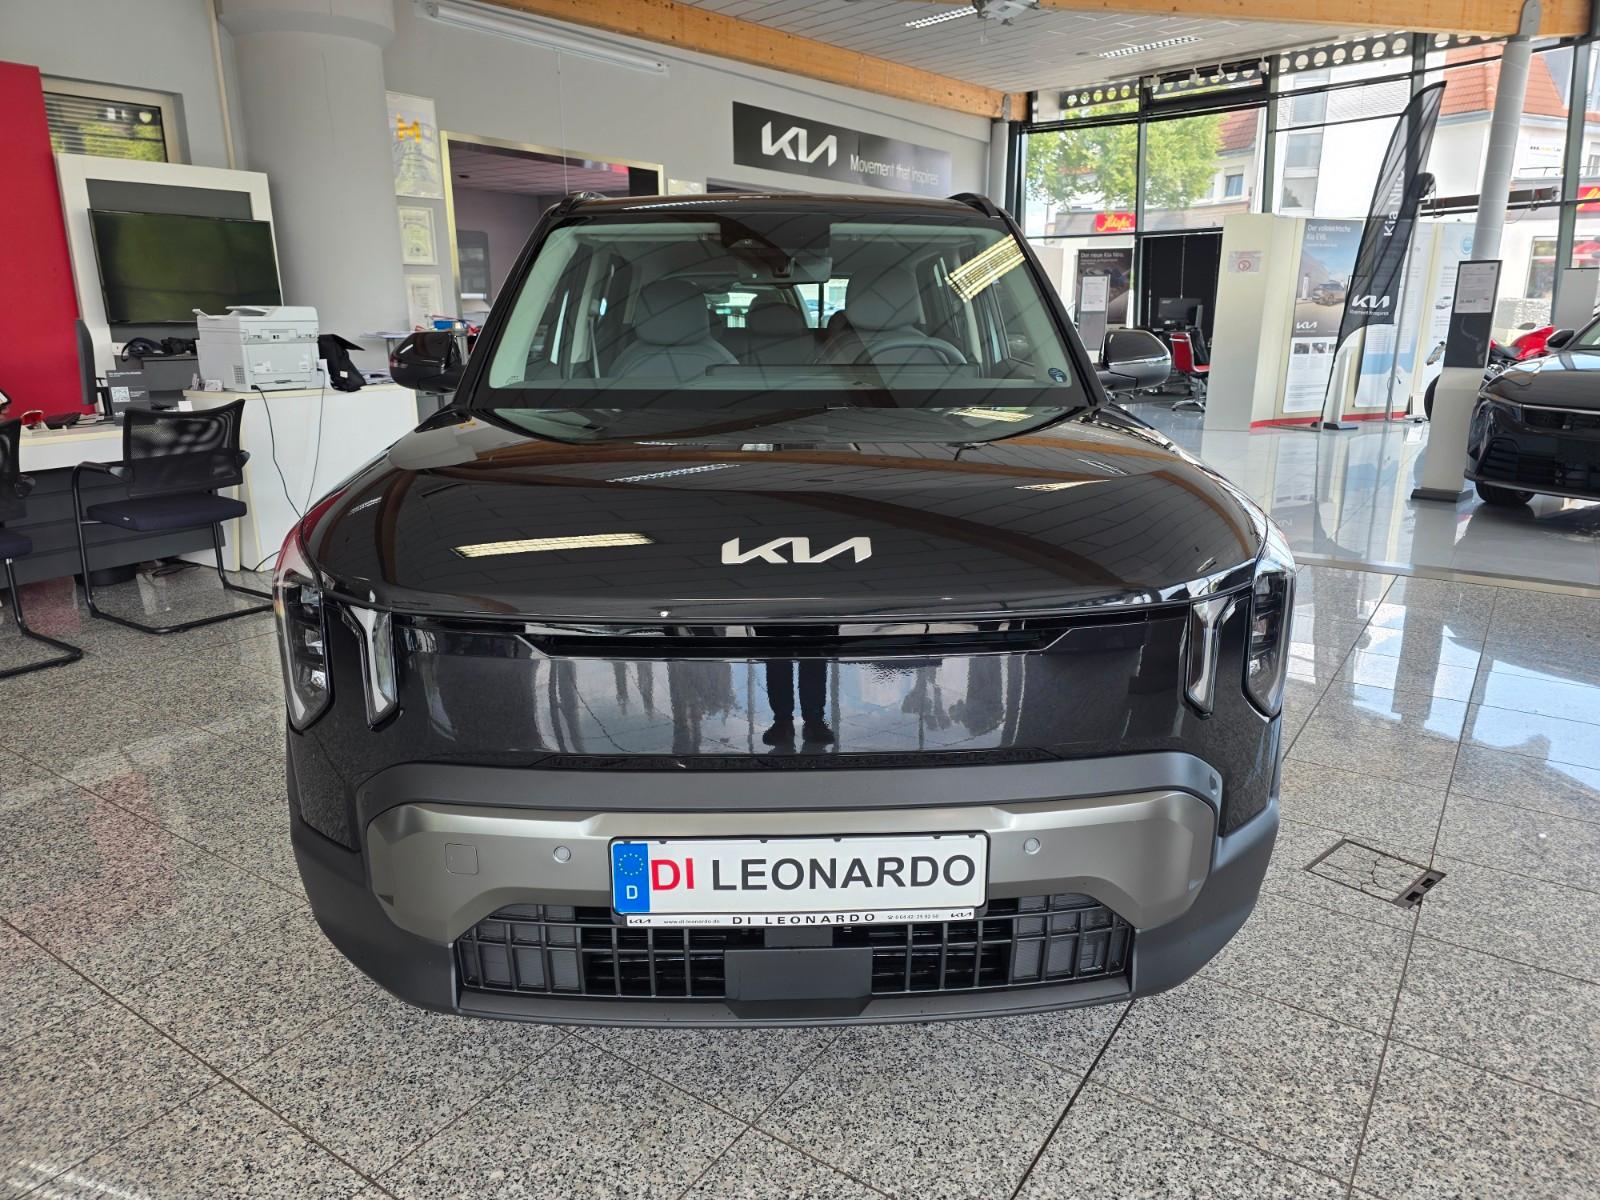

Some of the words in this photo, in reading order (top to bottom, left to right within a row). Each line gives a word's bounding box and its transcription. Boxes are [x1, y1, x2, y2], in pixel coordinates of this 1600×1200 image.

[761, 121, 838, 167] KIA
[850, 153, 895, 178] Movement
[896, 163, 911, 180] that
[911, 165, 940, 186] inspires
[1384, 211, 1399, 236] Kia
[1352, 294, 1390, 308] KIA
[1296, 321, 1318, 329] KIA
[721, 536, 873, 564] KIA
[651, 858, 695, 890] DI
[712, 855, 976, 890] LEONARDO
[626, 885, 639, 900] D
[732, 916, 752, 925] DI
[764, 913, 876, 925] LEONARDO
